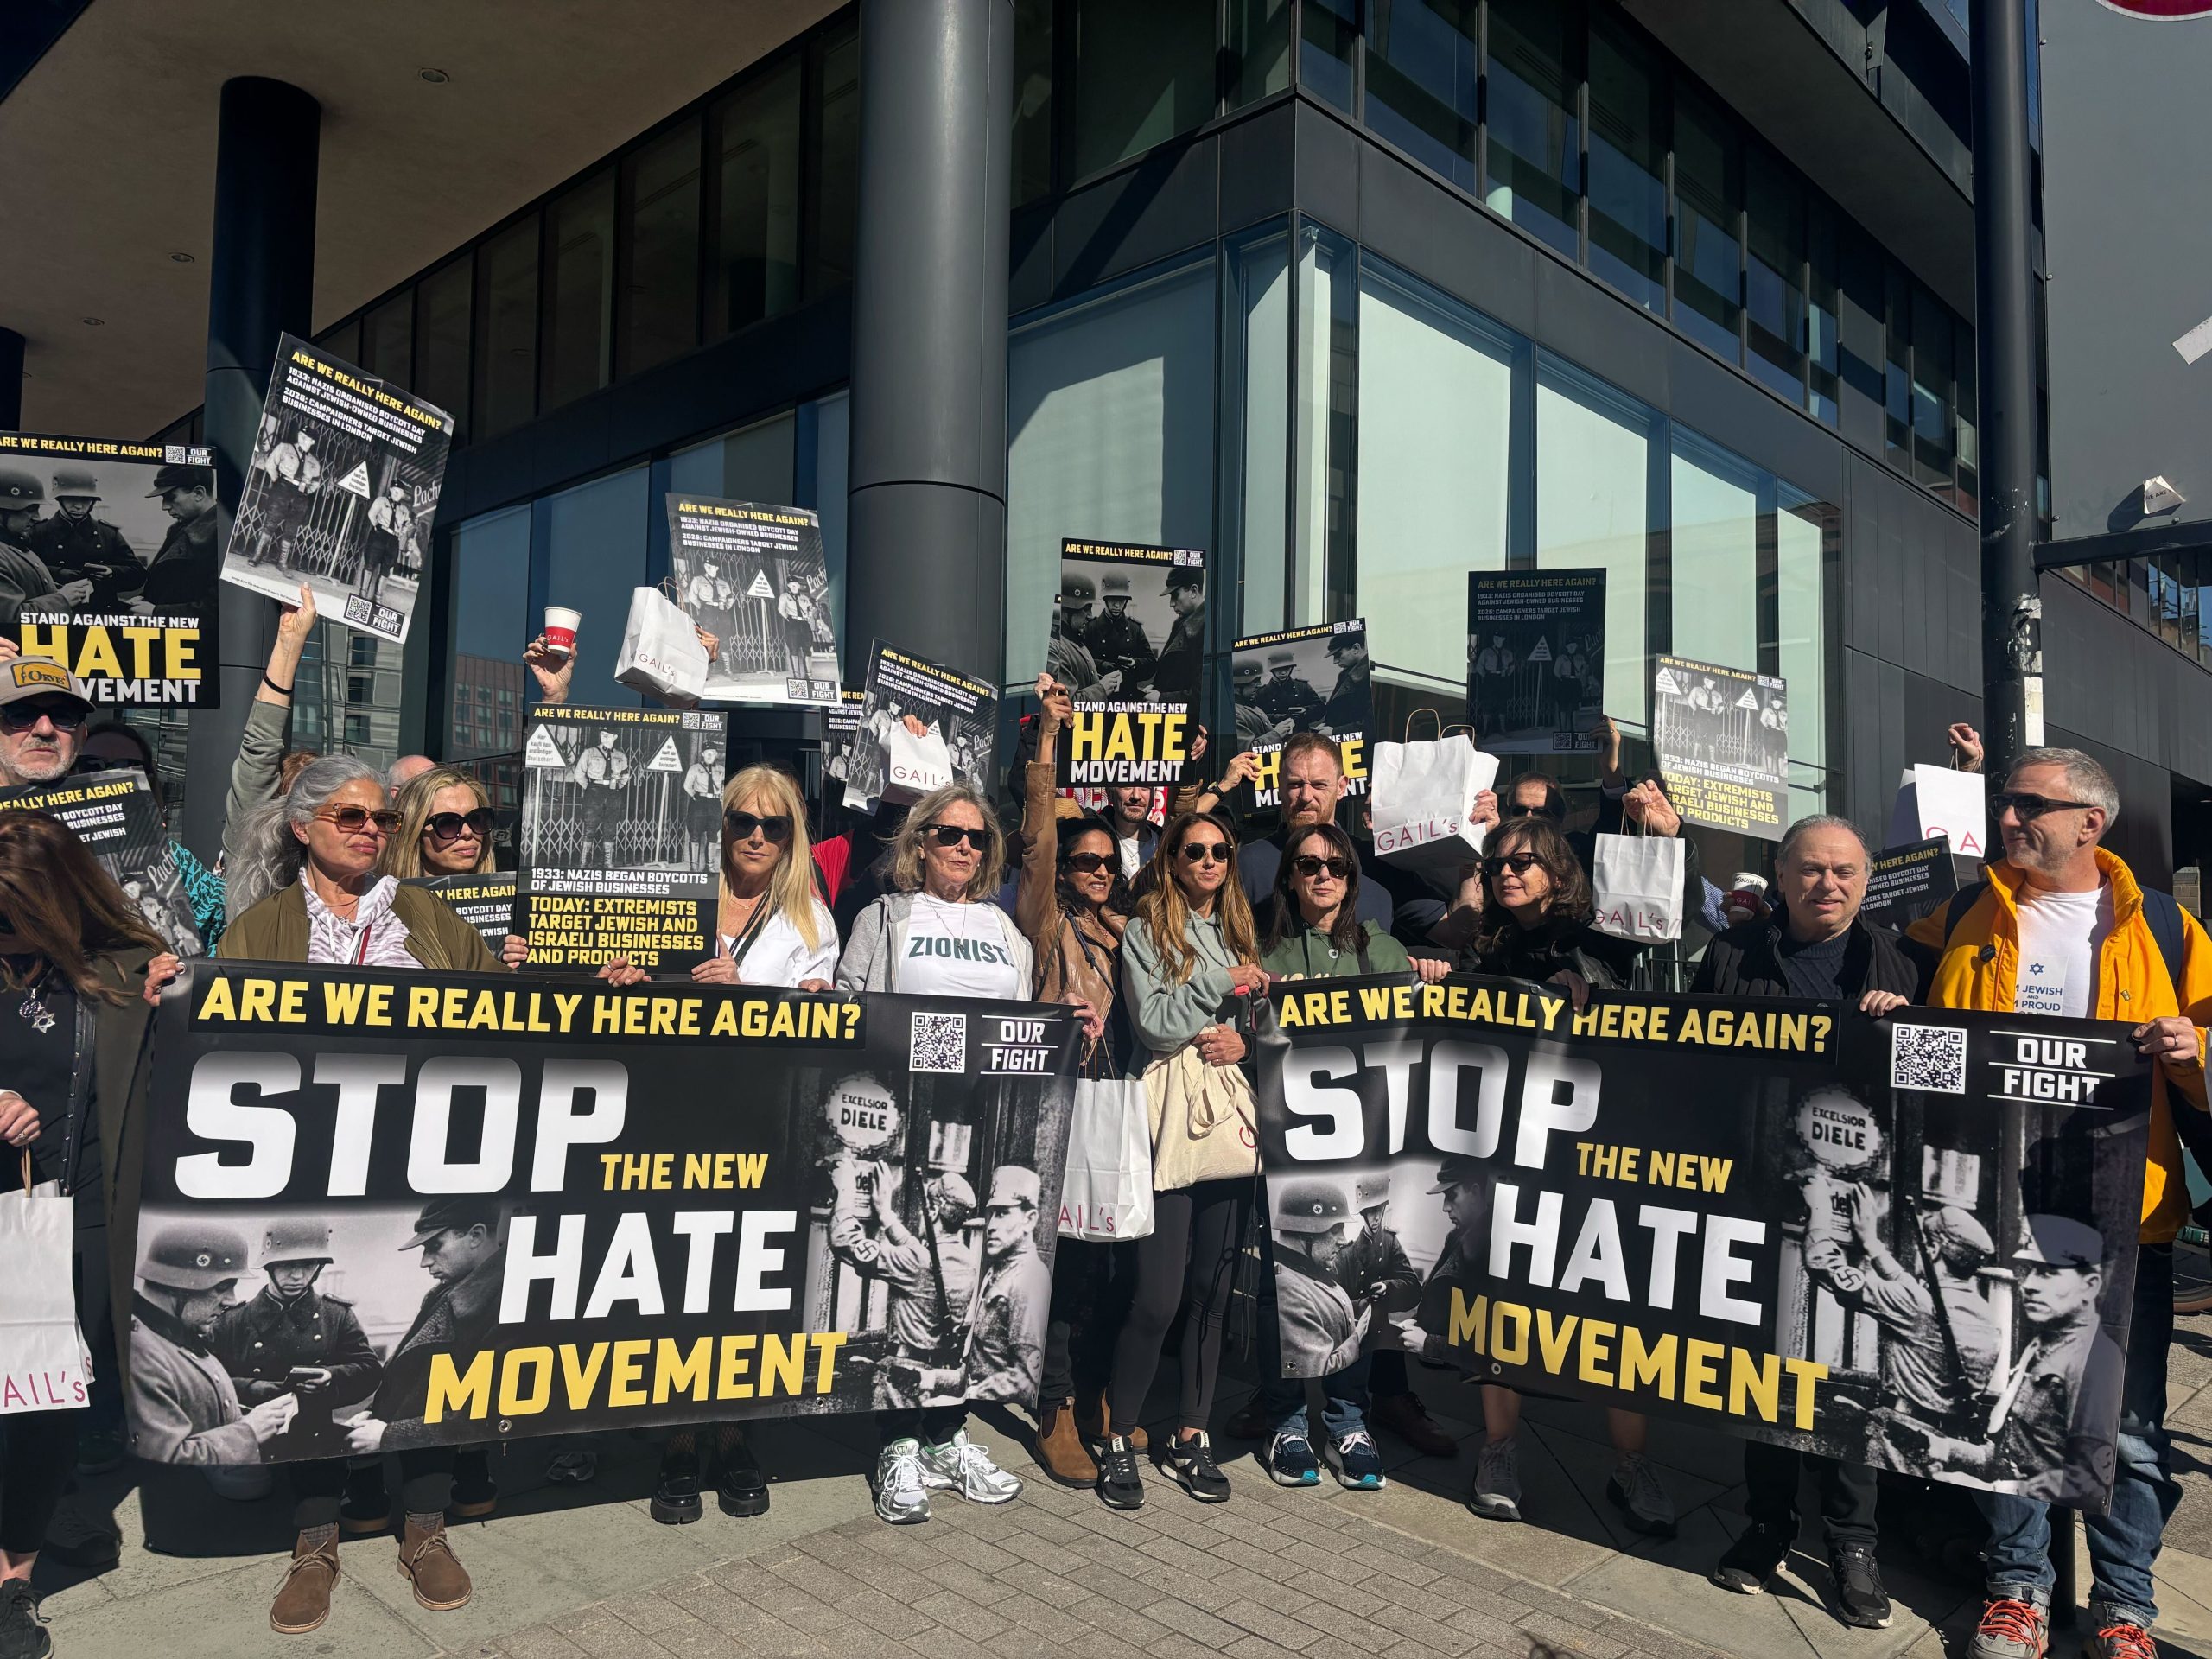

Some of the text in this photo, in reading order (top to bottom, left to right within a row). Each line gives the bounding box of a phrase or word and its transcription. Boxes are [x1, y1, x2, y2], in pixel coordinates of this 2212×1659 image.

[289, 366, 425, 435] 1933: NAZIS ORGANISED BOYCOTT DAY
[291, 352, 441, 429] ARE WE REALLY HERE AGAIN?
[283, 396, 372, 442] BUSINESSES IN LONDON
[287, 375, 422, 443] AGAINST JEWISH-OWNED BUSINESSES
[284, 387, 416, 454] 2026: CAMPAIGNERS TARGET JEWISH
[21, 438, 37, 448] WE
[41, 439, 84, 451] REALLY
[87, 442, 118, 454] HERE
[120, 445, 162, 457] AGAIN?
[188, 456, 210, 465] FIGHT
[679, 503, 808, 525] ARE WE REALLY HERE AGAIN?
[1065, 543, 1173, 560] ARE WE REALLY HERE AGAIN?
[1478, 580, 1494, 588] ARE
[1510, 579, 1540, 588] REALLY
[20, 612, 198, 629] STAND AGAINST THE NEW
[373, 616, 399, 632] FIGHT
[378, 608, 397, 621] OUR
[1260, 633, 1285, 643] REALLY
[1306, 626, 1332, 635] AGAIN?
[19, 624, 200, 680] HATE
[881, 649, 988, 696] ARE WE REALLY HERE AGAIN?
[76, 678, 200, 702] VEMENT
[534, 708, 679, 723] ARE WE REALLY HERE AGAIN?
[1073, 702, 1187, 713] STAND AGAINST THE NEW
[1072, 712, 1186, 760] HATE
[1071, 761, 1183, 782] MOVEMENT
[47, 782, 133, 805] HERE AGAIN?
[1662, 772, 1772, 801] TODAY: EXTREMISTS
[1667, 782, 1773, 812] ARGET JEWISH AND
[63, 803, 122, 820] BOYCOTT DAY
[1672, 795, 1778, 824] RAELI BUSINESSES
[1687, 808, 1748, 829] PRODUCTS
[67, 813, 124, 829] BUSINESSES
[92, 828, 125, 840] JEWISH
[1881, 848, 1938, 868] HERE AGAIN?
[532, 868, 707, 883] 1933: NAZIS BEGAN BOYCOTTS
[447, 887, 479, 899] HERE
[531, 880, 669, 894] OF JEWISH BUSINESSES
[531, 896, 696, 915] TODAY: EXTREMISTS
[530, 913, 697, 932] TARGET JEWISH AND
[529, 931, 703, 950] ISRAELI BUSINESSES
[526, 949, 563, 963] AND
[2023, 985, 2063, 995] JEWISH
[198, 977, 860, 1038] ARE WE REALLY HERE AGAIN?
[2022, 1001, 2061, 1011] PROUD
[1279, 984, 1831, 1052] ARE WE REALLY HERE AGAIN?
[1001, 1020, 1045, 1042] OUR
[991, 1048, 1048, 1070] FIGHT
[2016, 1037, 2085, 1069] OUR
[2002, 1069, 2101, 1103] FIGHT
[842, 1094, 887, 1111] EXCELSIOR
[1282, 1039, 1603, 1172] STOP
[175, 1050, 630, 1199] STOP
[841, 1109, 886, 1130] DIELE
[1812, 1106, 1866, 1129] EXCELSIOR
[1811, 1122, 1865, 1152] DIELE
[601, 1154, 767, 1190] THE NEW
[1577, 1142, 1732, 1193] THE NEW
[1058, 1204, 1114, 1231] AIL's
[1489, 1182, 1765, 1327] HATE
[499, 1211, 796, 1324] HATE
[1449, 1285, 1830, 1430] MOVEMENT
[424, 1329, 847, 1424] MOVEMENT
[3, 1370, 84, 1407] AIL's
